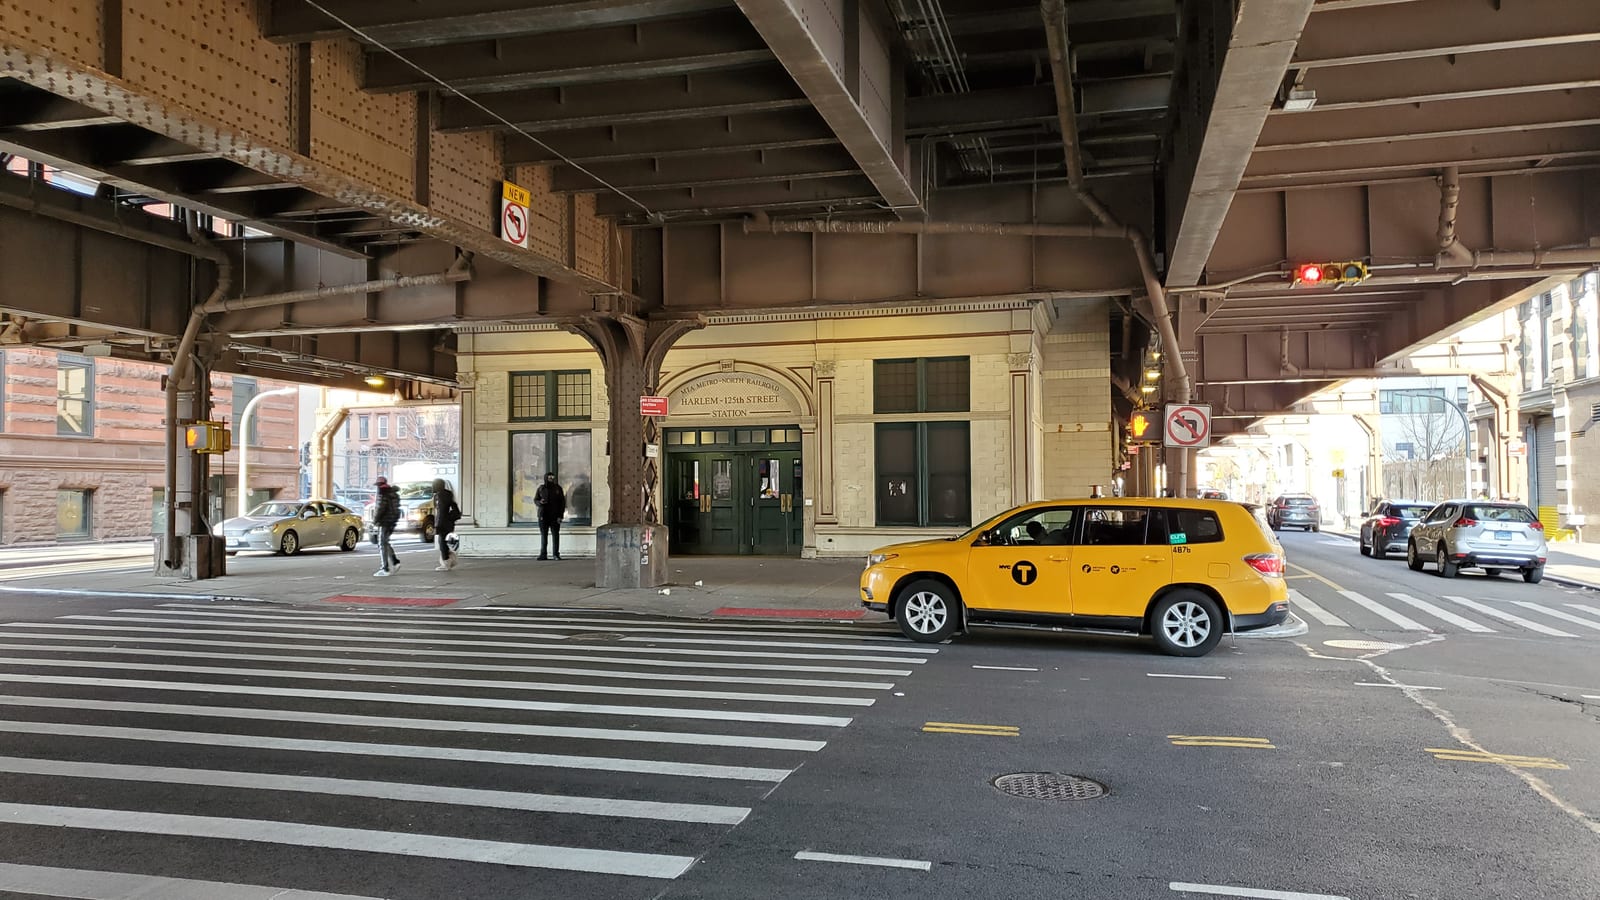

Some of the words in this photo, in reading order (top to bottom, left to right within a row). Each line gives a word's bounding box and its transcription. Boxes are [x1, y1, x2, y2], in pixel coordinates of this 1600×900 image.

[508, 187, 525, 202] NEW
[680, 385, 695, 395] MTA
[746, 378, 780, 391] RAILROAD
[681, 397, 718, 406] HARLEM
[724, 396, 745, 404] 125th
[746, 395, 780, 404] STREET
[711, 409, 747, 418] STATION
